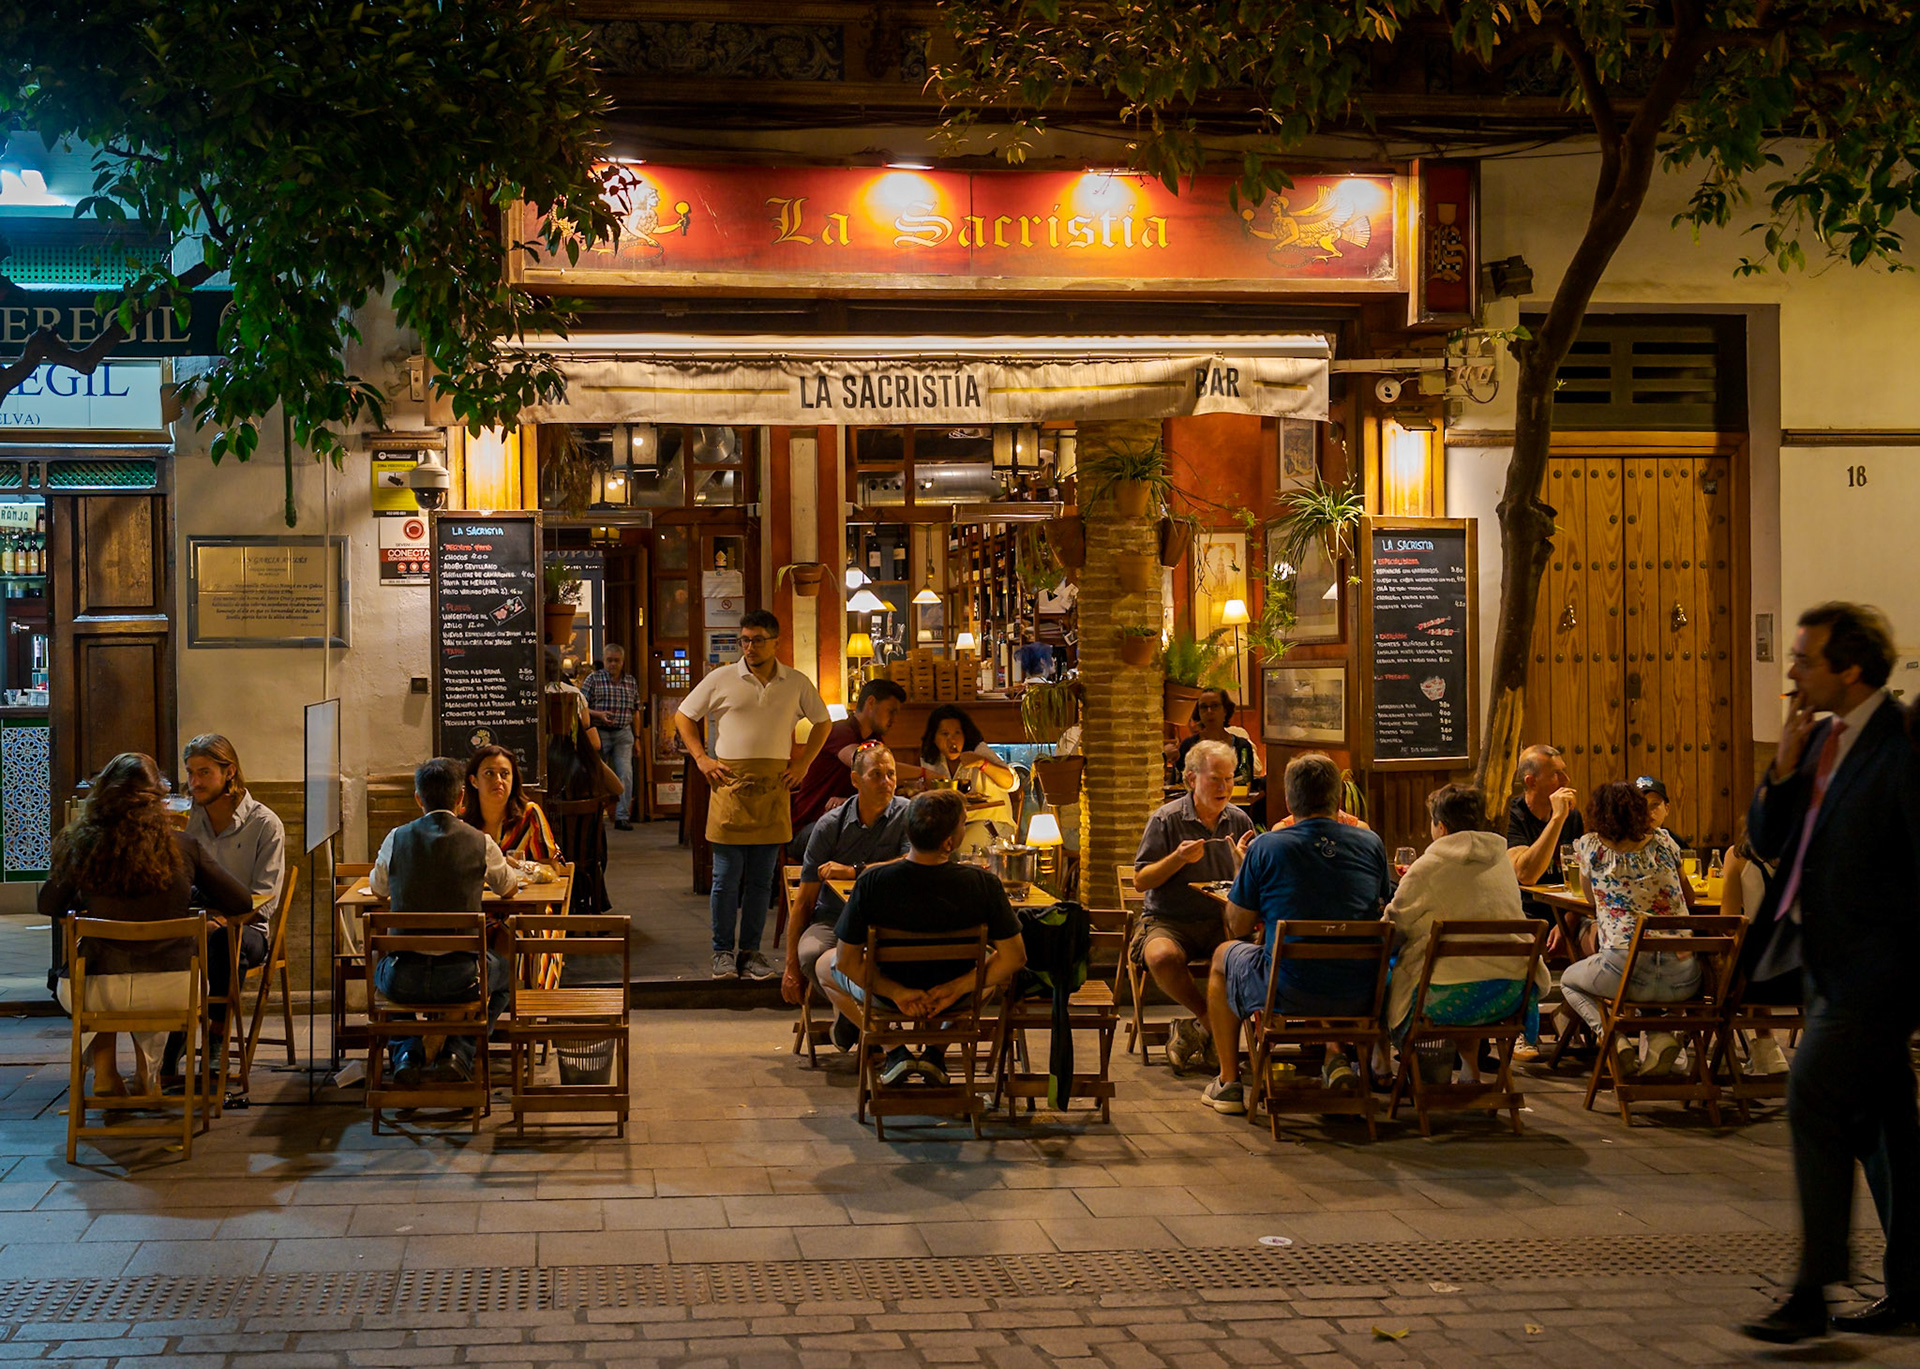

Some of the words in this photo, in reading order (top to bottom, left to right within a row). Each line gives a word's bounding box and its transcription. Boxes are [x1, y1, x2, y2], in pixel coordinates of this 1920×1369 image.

[764, 196, 853, 247] La
[8, 363, 130, 397] EGIL
[800, 375, 832, 409] LA
[842, 370, 981, 409] SACRISTÍA
[1195, 367, 1241, 399] BAR
[1847, 465, 1867, 487] 18
[452, 526, 464, 536] LA
[387, 549, 430, 557] CONECTA
[1382, 539, 1394, 551] LA
